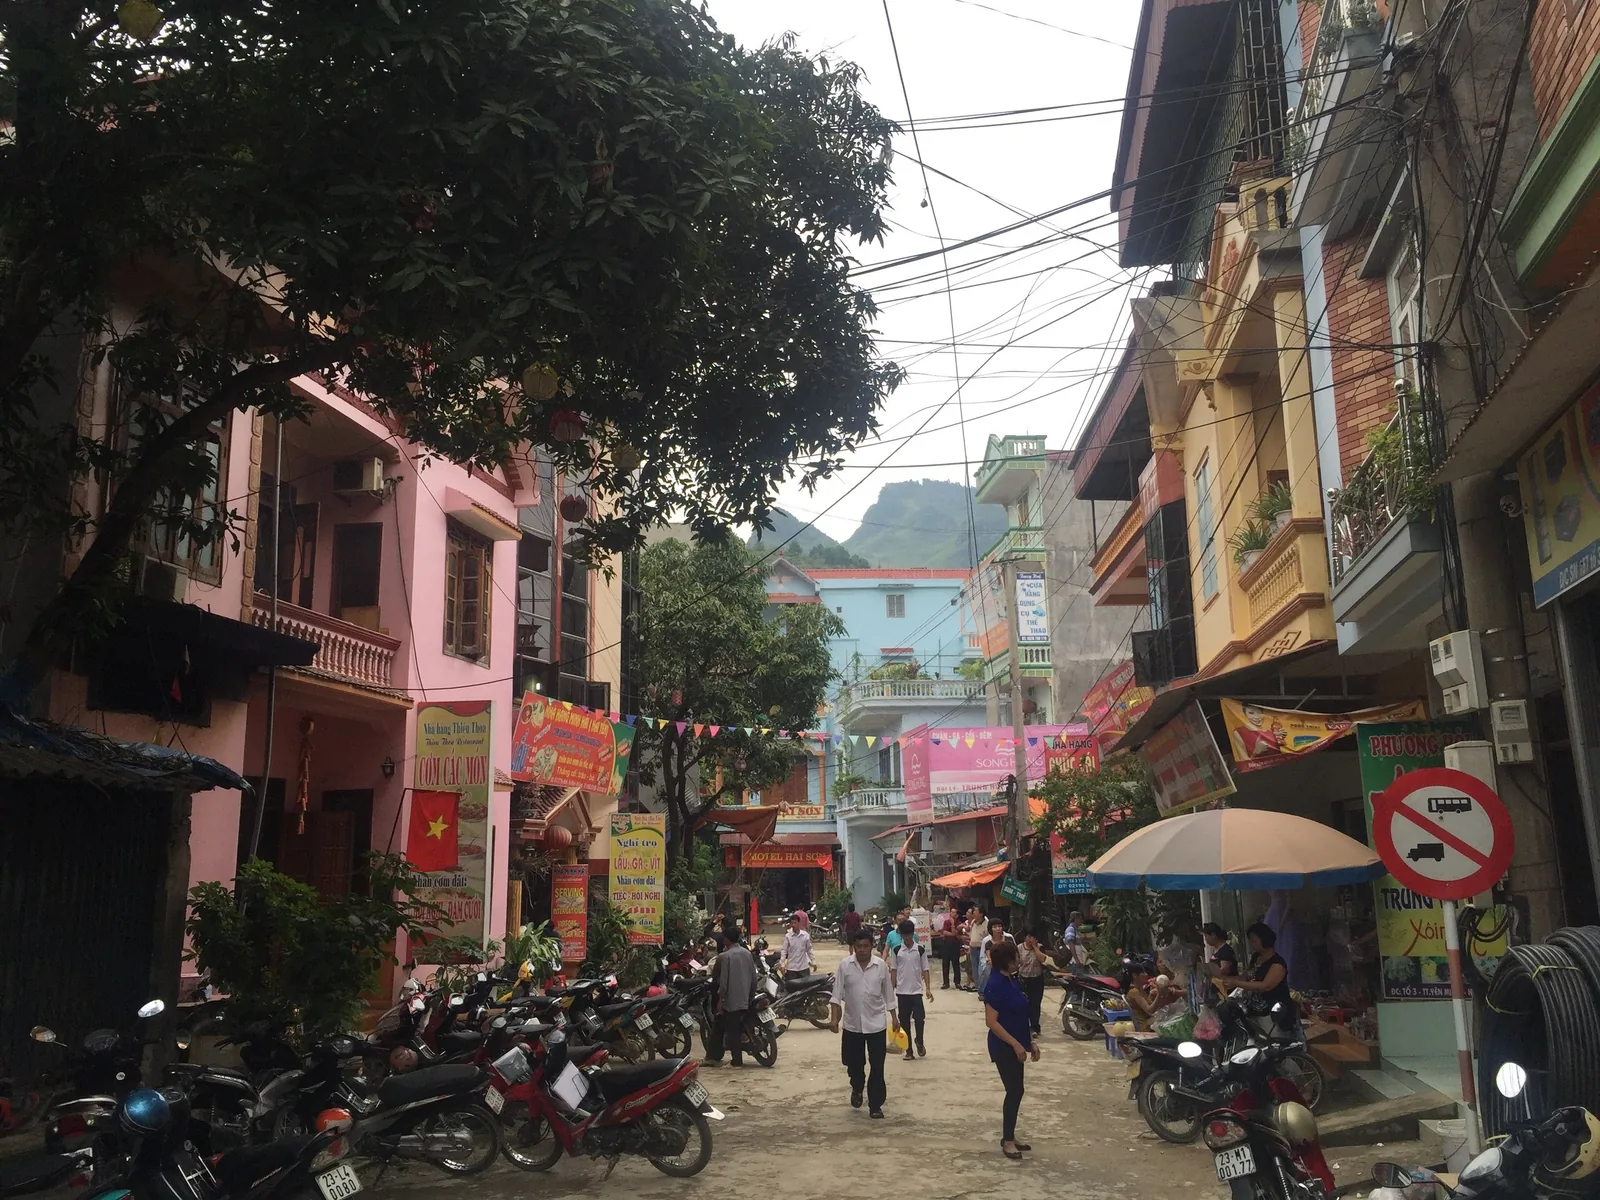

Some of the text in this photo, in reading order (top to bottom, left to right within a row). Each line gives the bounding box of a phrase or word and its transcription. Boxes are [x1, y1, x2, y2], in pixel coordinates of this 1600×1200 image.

[1369, 732, 1438, 757] PHƯƠNG
[419, 752, 441, 786] CƠM
[443, 748, 463, 785] CÁC
[465, 746, 488, 785] MÓN
[798, 806, 822, 816] SƠN
[555, 887, 584, 898] SERVING
[1380, 888, 1434, 911] TRUNG
[322, 1165, 350, 1188] 23-L4
[1218, 1159, 1251, 1180] 001.77
[329, 1179, 357, 1200] 0080
